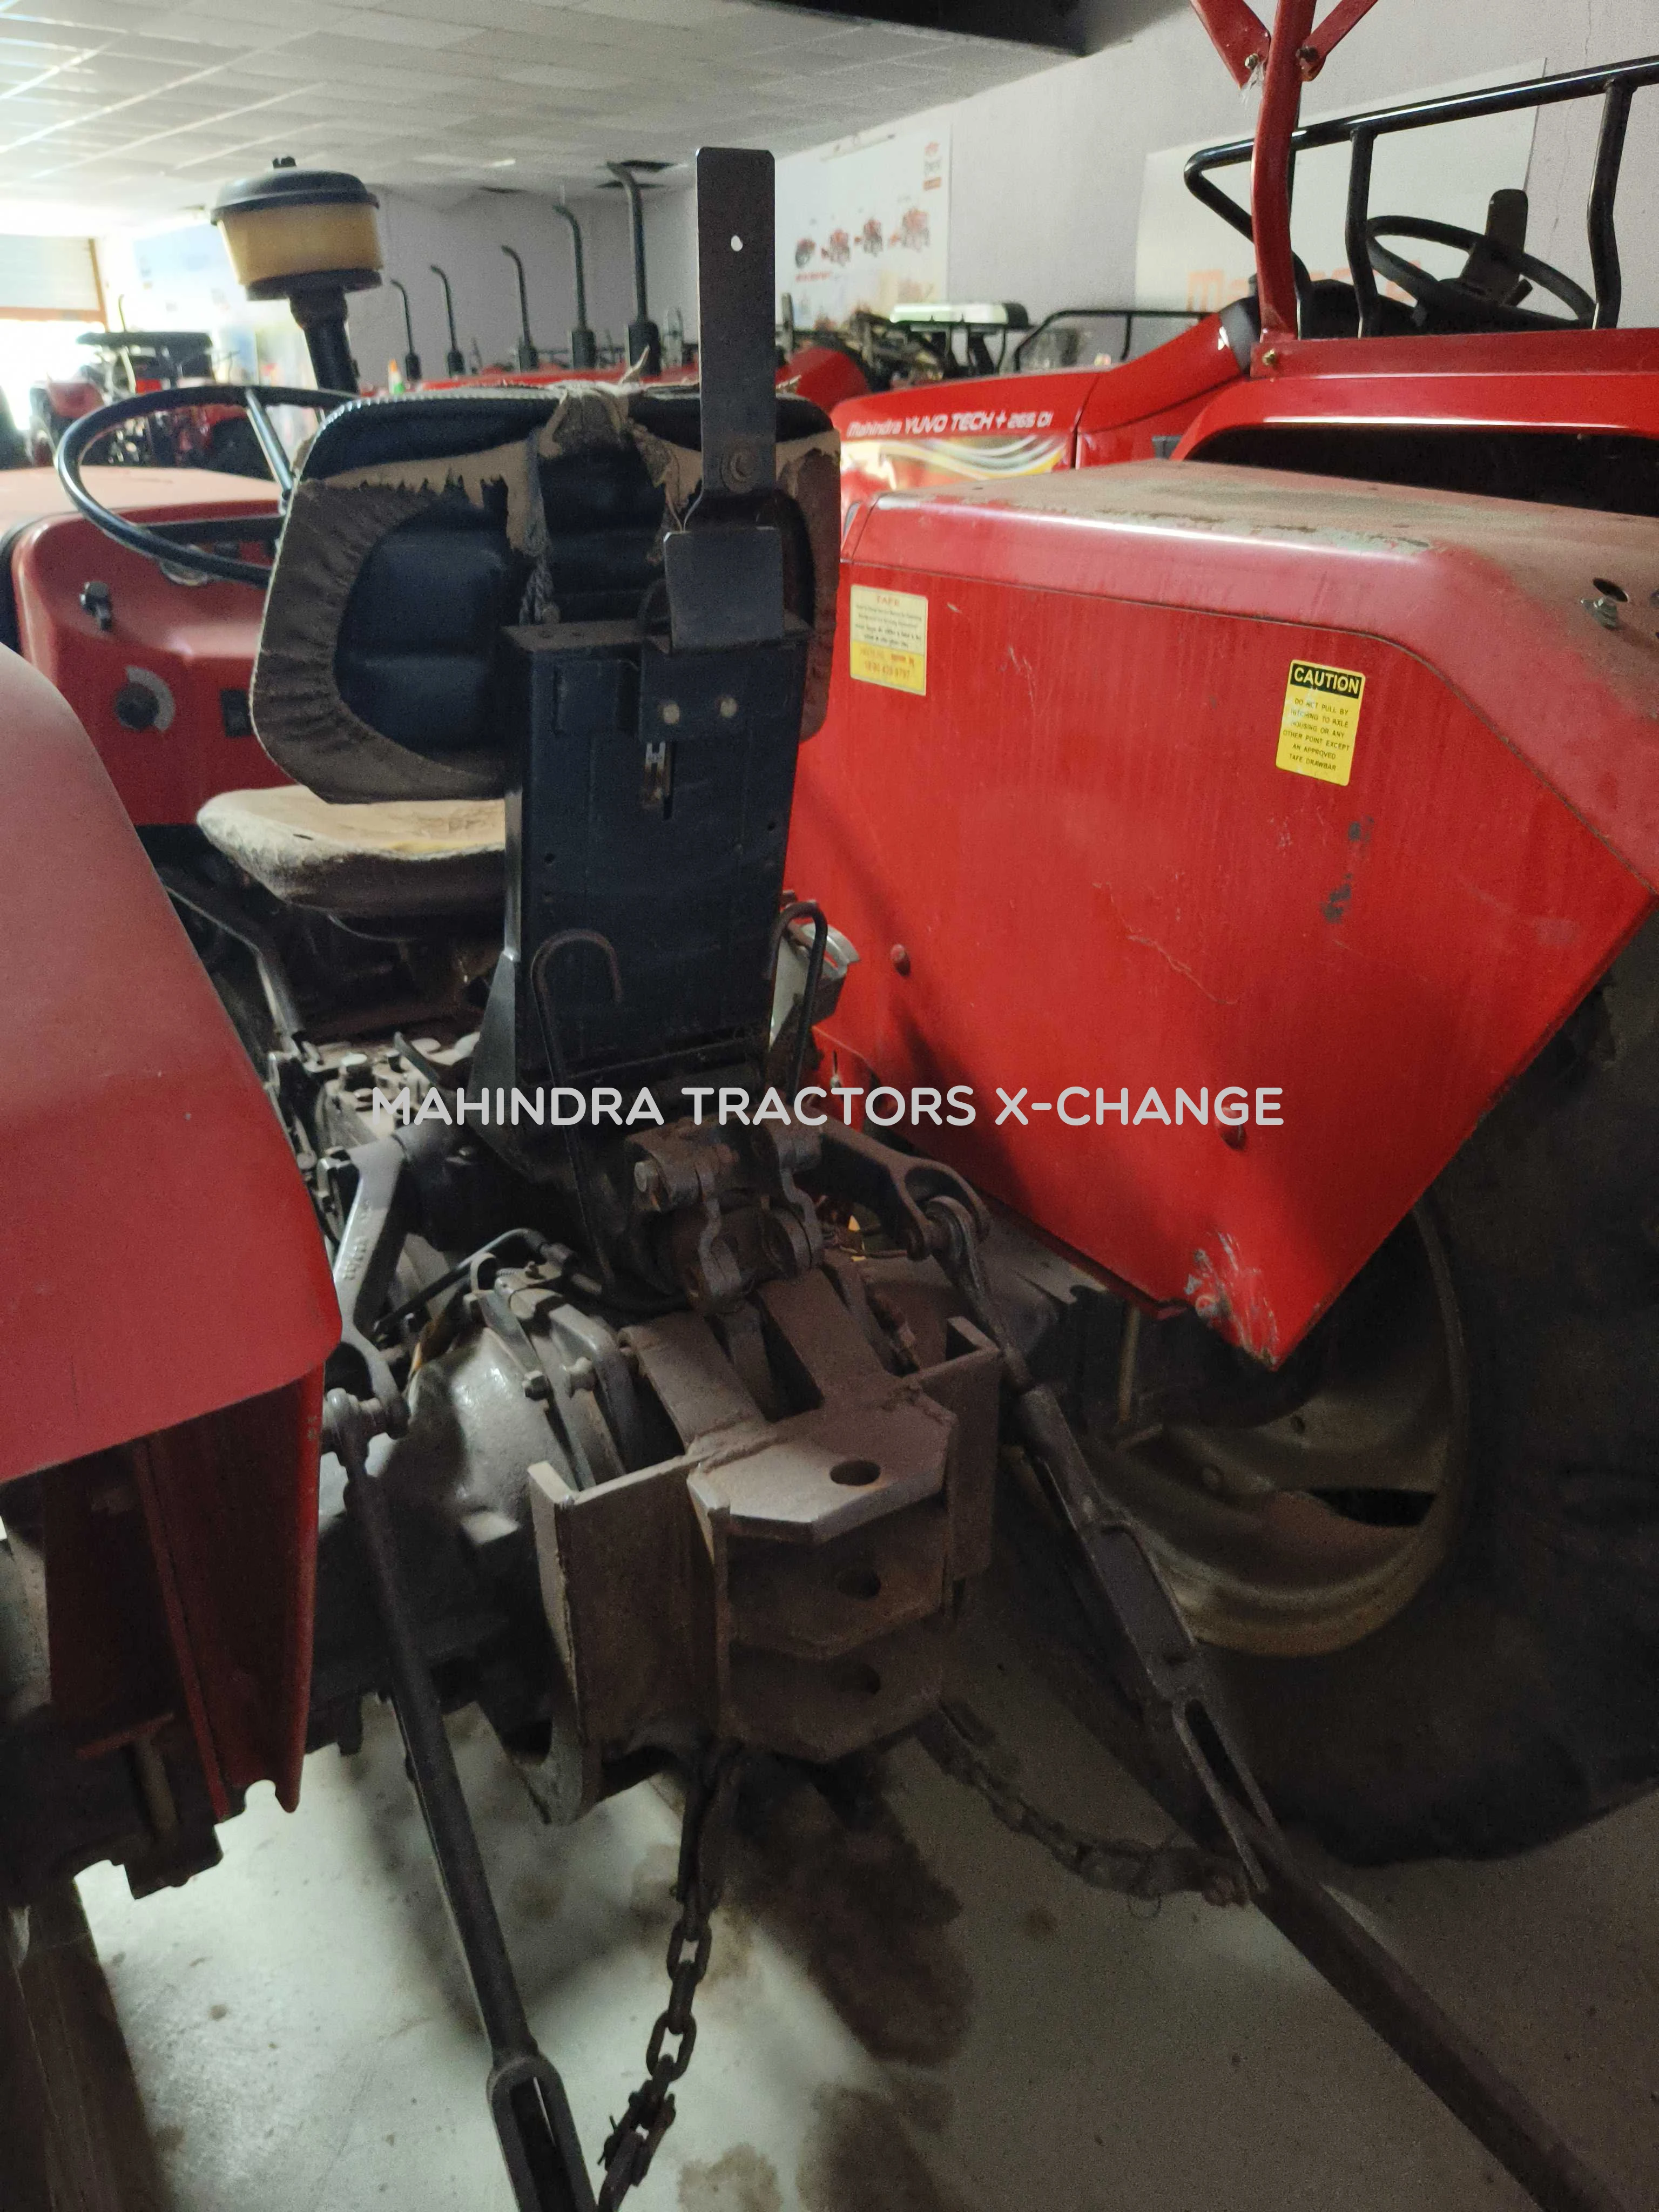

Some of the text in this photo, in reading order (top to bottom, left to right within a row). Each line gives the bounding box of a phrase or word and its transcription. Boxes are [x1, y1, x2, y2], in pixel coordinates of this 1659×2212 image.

[905, 414, 948, 434] YUVO
[1294, 667, 1359, 694] CAUTION
[1321, 704, 1337, 713] PULL
[1291, 720, 1318, 732] HOUSING
[1332, 730, 1345, 738] ANY
[1332, 718, 1348, 728] AXLE
[1283, 730, 1350, 751] OTHER POINT EXCEPT
[1289, 753, 1337, 771] TAFE DRAWBAR
[1304, 747, 1336, 759] APPROVED
